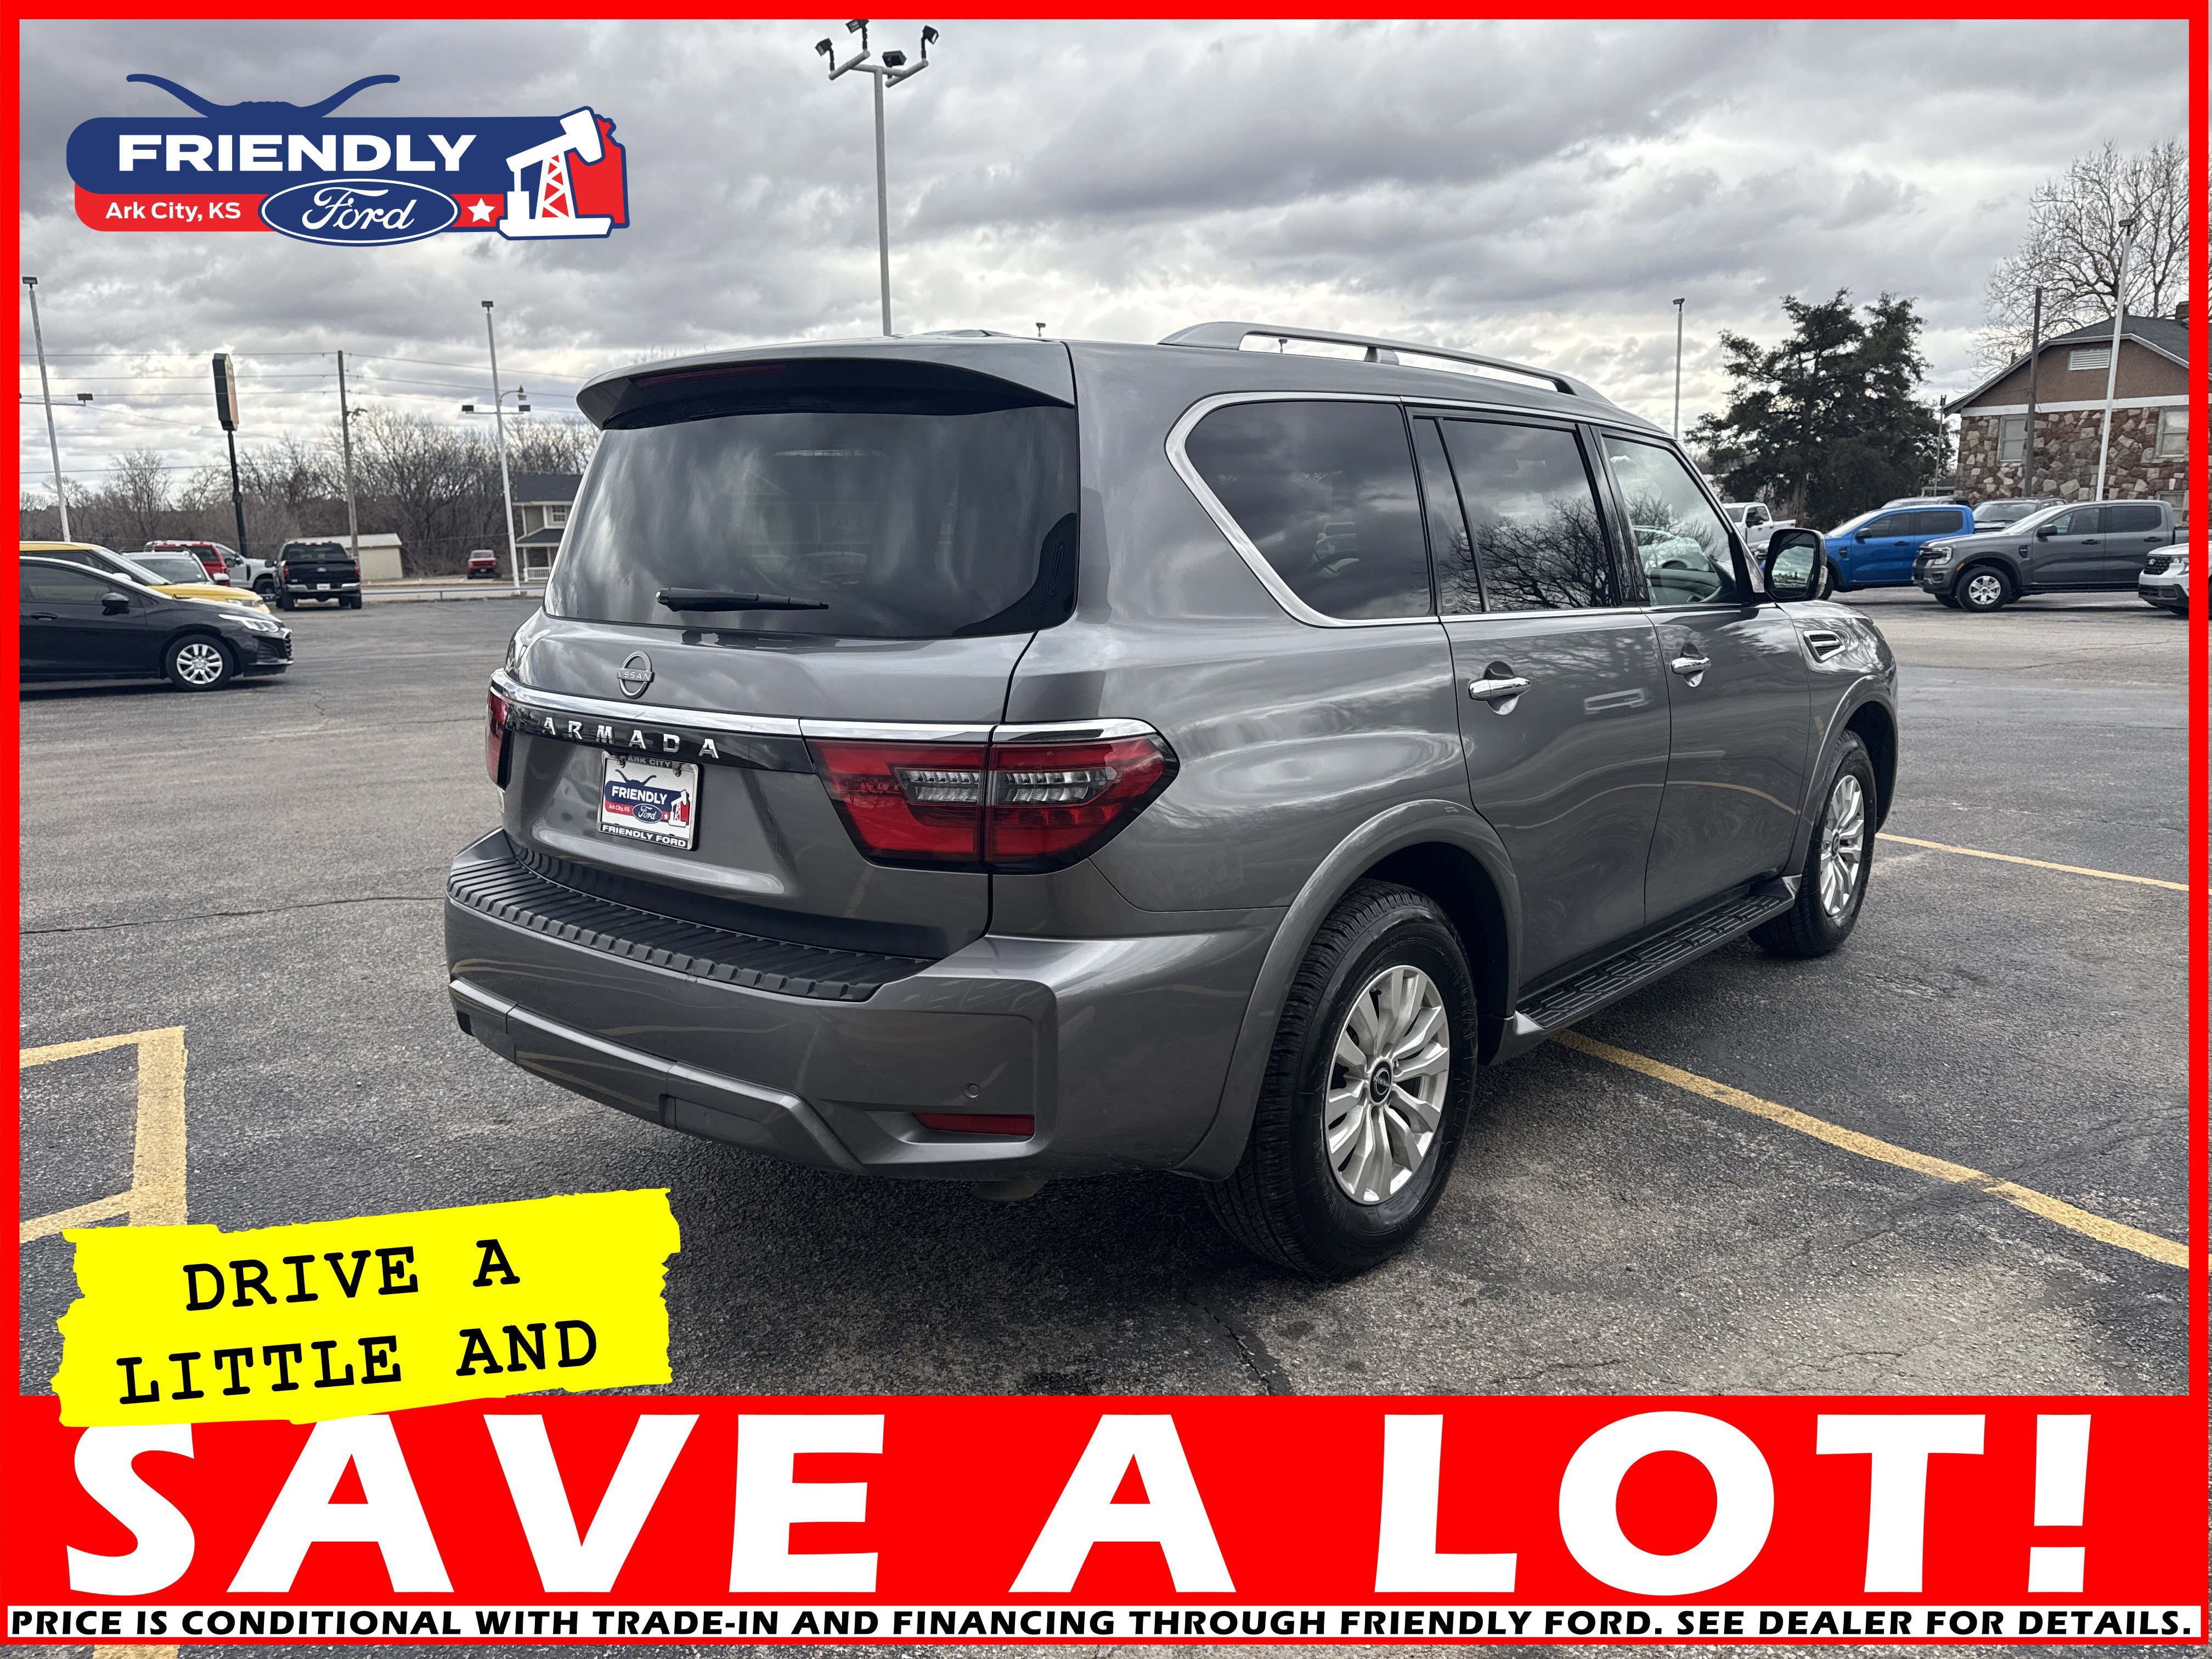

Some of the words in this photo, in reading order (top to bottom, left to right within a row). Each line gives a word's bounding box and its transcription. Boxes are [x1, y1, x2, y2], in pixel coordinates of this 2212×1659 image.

[541, 716, 720, 759] ARMADA
[628, 756, 647, 765] ARK
[649, 759, 671, 768] CITY
[612, 786, 668, 805] FRIENDLY
[638, 805, 657, 820] Ford
[602, 825, 656, 840] FRIENDLY
[656, 835, 686, 848] FORD
